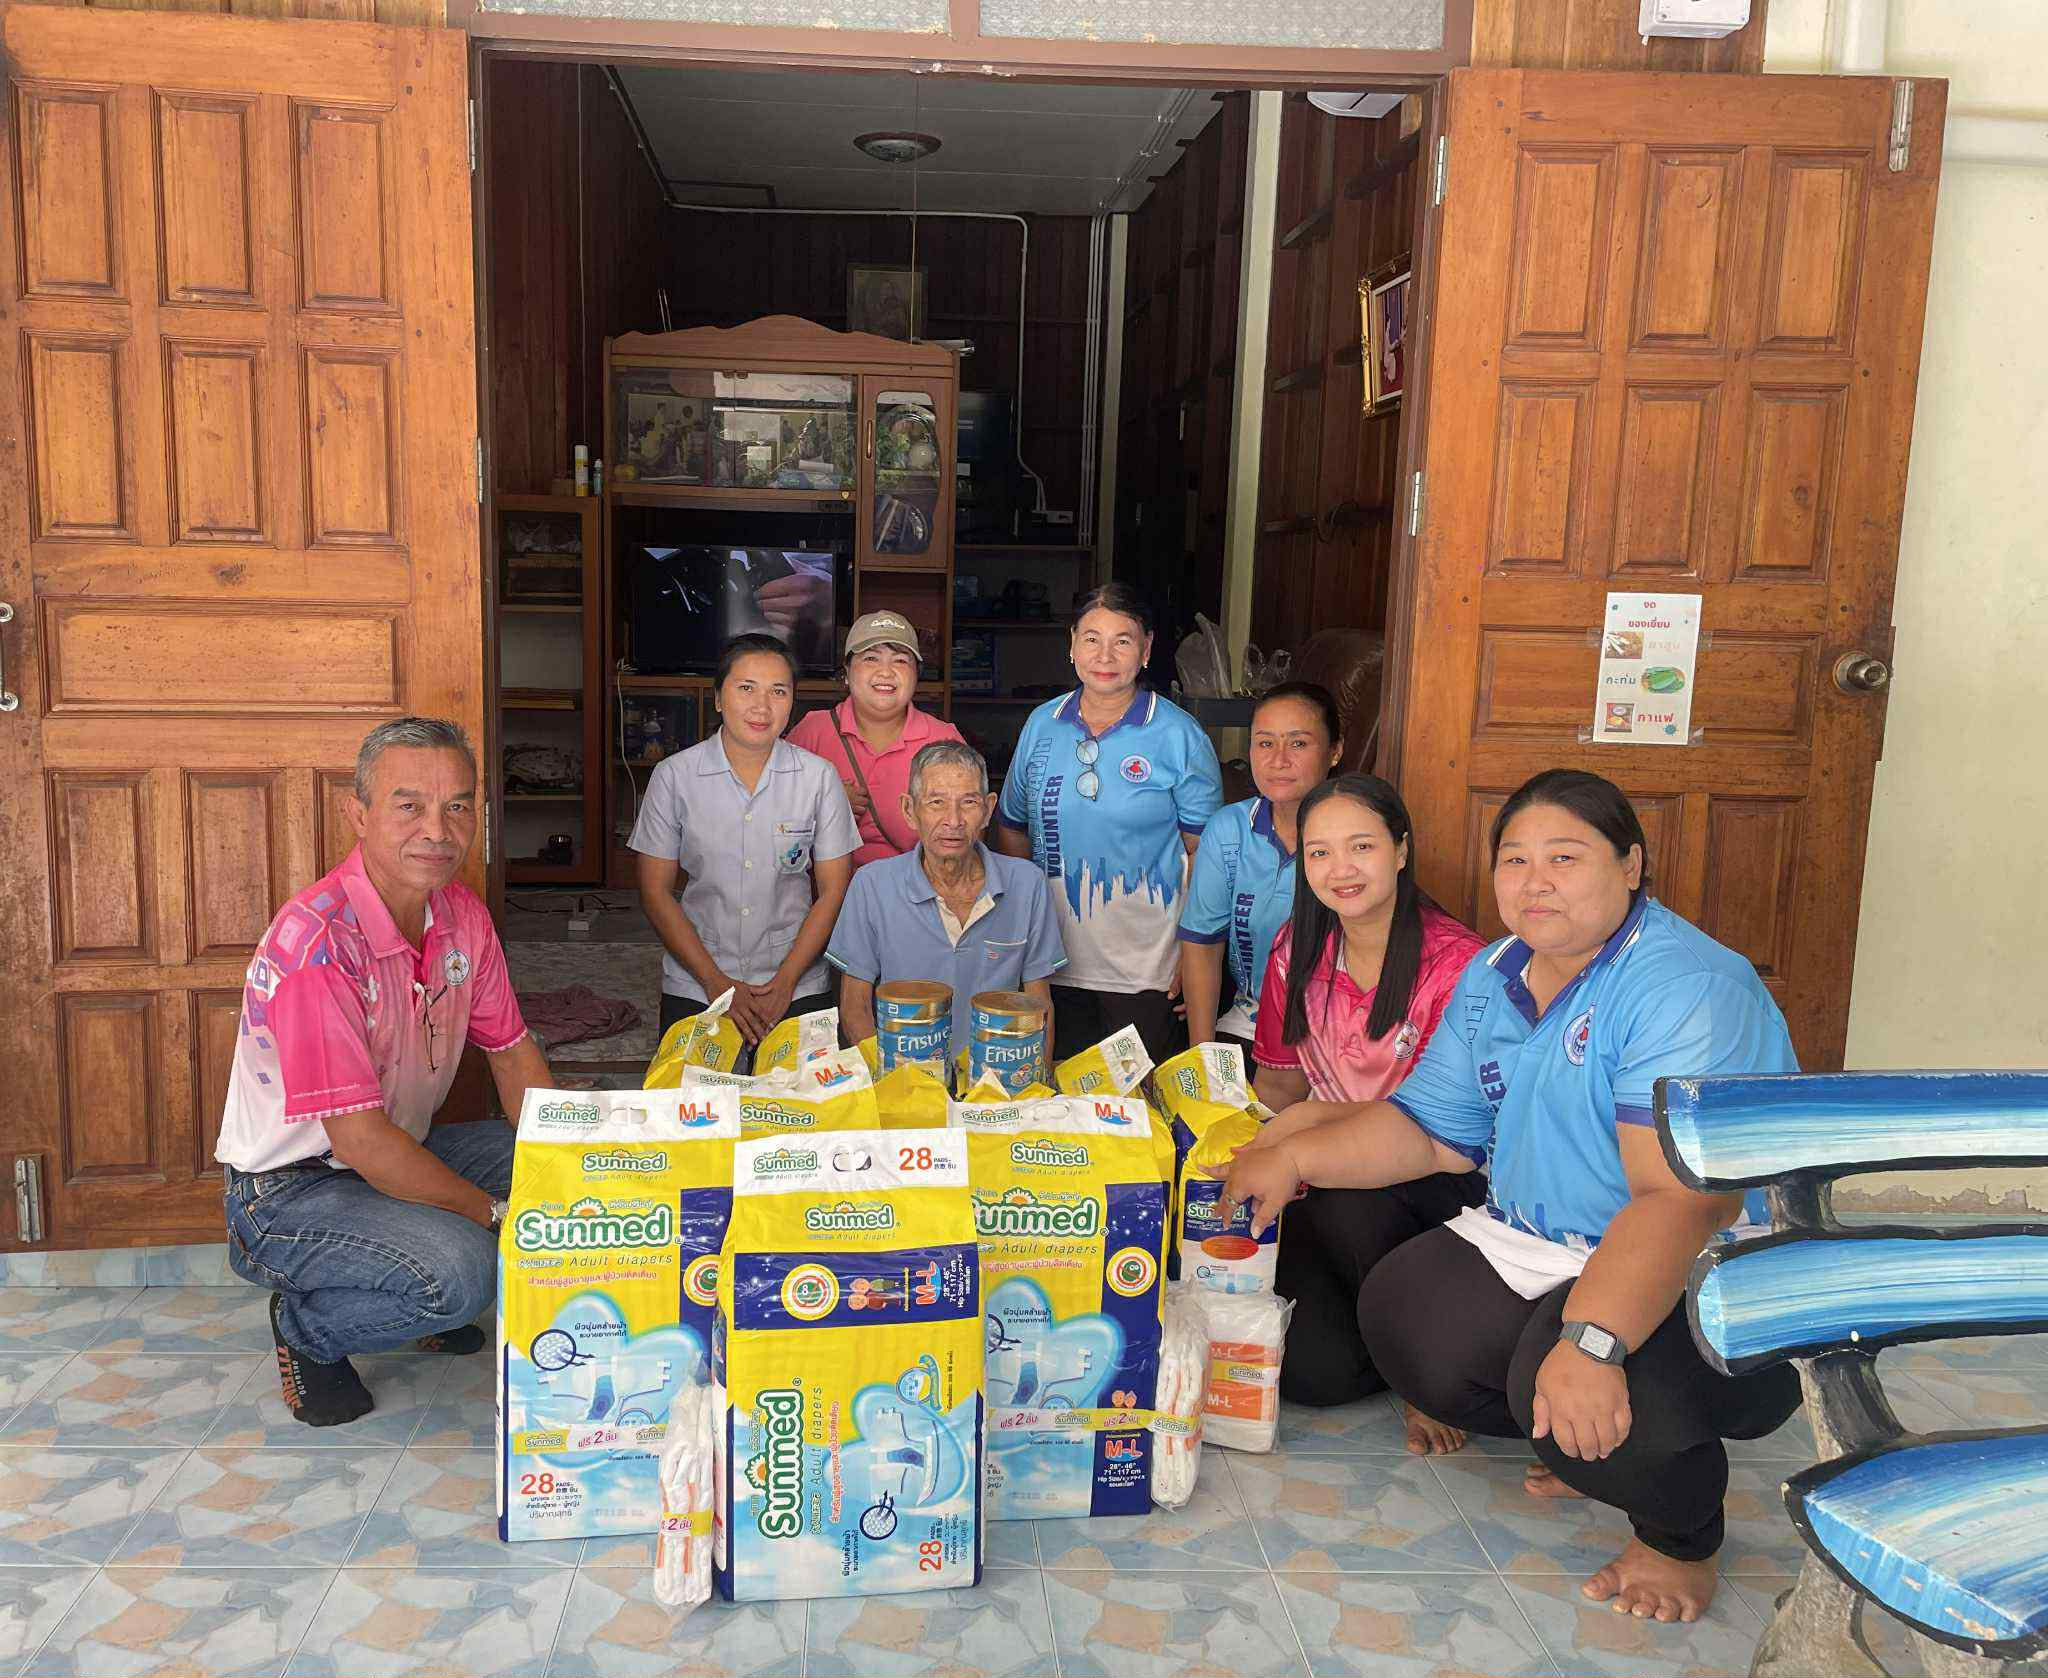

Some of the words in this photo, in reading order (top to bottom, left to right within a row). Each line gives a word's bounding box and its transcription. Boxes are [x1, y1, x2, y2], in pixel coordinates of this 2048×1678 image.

[1637, 713, 1674, 723] กาแฟ
[1042, 775, 1063, 877] VOLUNTEER
[897, 1026, 951, 1052] Ensure
[985, 1041, 1041, 1063] Ensure
[815, 1064, 852, 1086] M-L
[540, 1104, 599, 1122] Sunmed
[679, 1102, 718, 1122] M-L
[741, 1106, 812, 1126] Sunmed
[962, 1107, 1019, 1122] Sunmed
[1094, 1102, 1132, 1122] M-L
[583, 1153, 666, 1171] Sunmed
[755, 1152, 817, 1172] Sunmed
[899, 1147, 933, 1171] 28
[1012, 1143, 1088, 1165] Sunmed
[807, 1204, 893, 1229] Sunmed
[974, 1199, 1096, 1235] unmed
[517, 1206, 670, 1248] Sunmed
[1001, 1244, 1037, 1255] Adult
[1045, 1246, 1097, 1257] diapers
[569, 1256, 608, 1267] Adult
[618, 1255, 672, 1267] diapers
[915, 1261, 938, 1304] M-L
[810, 1386, 823, 1440] diapers
[1015, 1413, 1025, 1425] 2
[1055, 1414, 1091, 1425] Sunmed
[1118, 1412, 1128, 1424] 2
[525, 1435, 561, 1447] Sunmed
[594, 1431, 604, 1443] 2
[1104, 1439, 1143, 1457] M-L
[758, 1392, 802, 1537] Sunmed
[810, 1448, 822, 1486] Adult
[521, 1473, 554, 1494] 28
[668, 1518, 678, 1531] 2
[919, 1541, 943, 1572] 28
